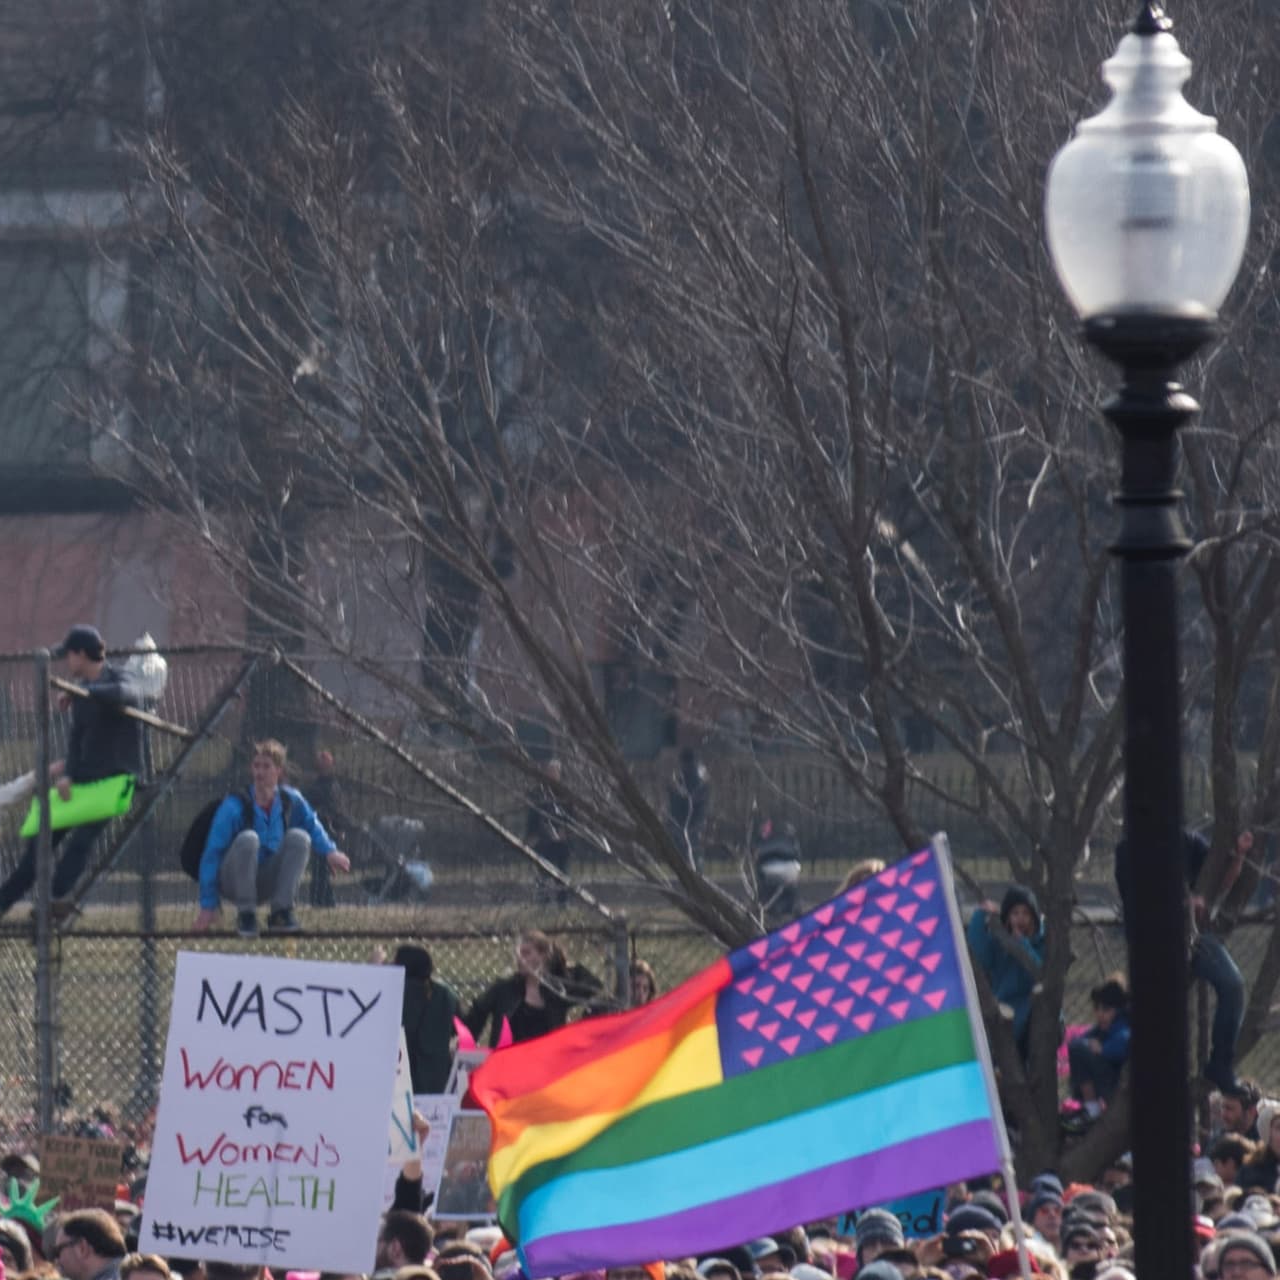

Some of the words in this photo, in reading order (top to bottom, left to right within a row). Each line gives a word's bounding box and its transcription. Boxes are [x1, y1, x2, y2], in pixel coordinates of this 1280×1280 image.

[196, 978, 382, 1038] NASTY
[193, 1170, 335, 1212] HEALTH
[152, 1219, 292, 1252] #WERISE
